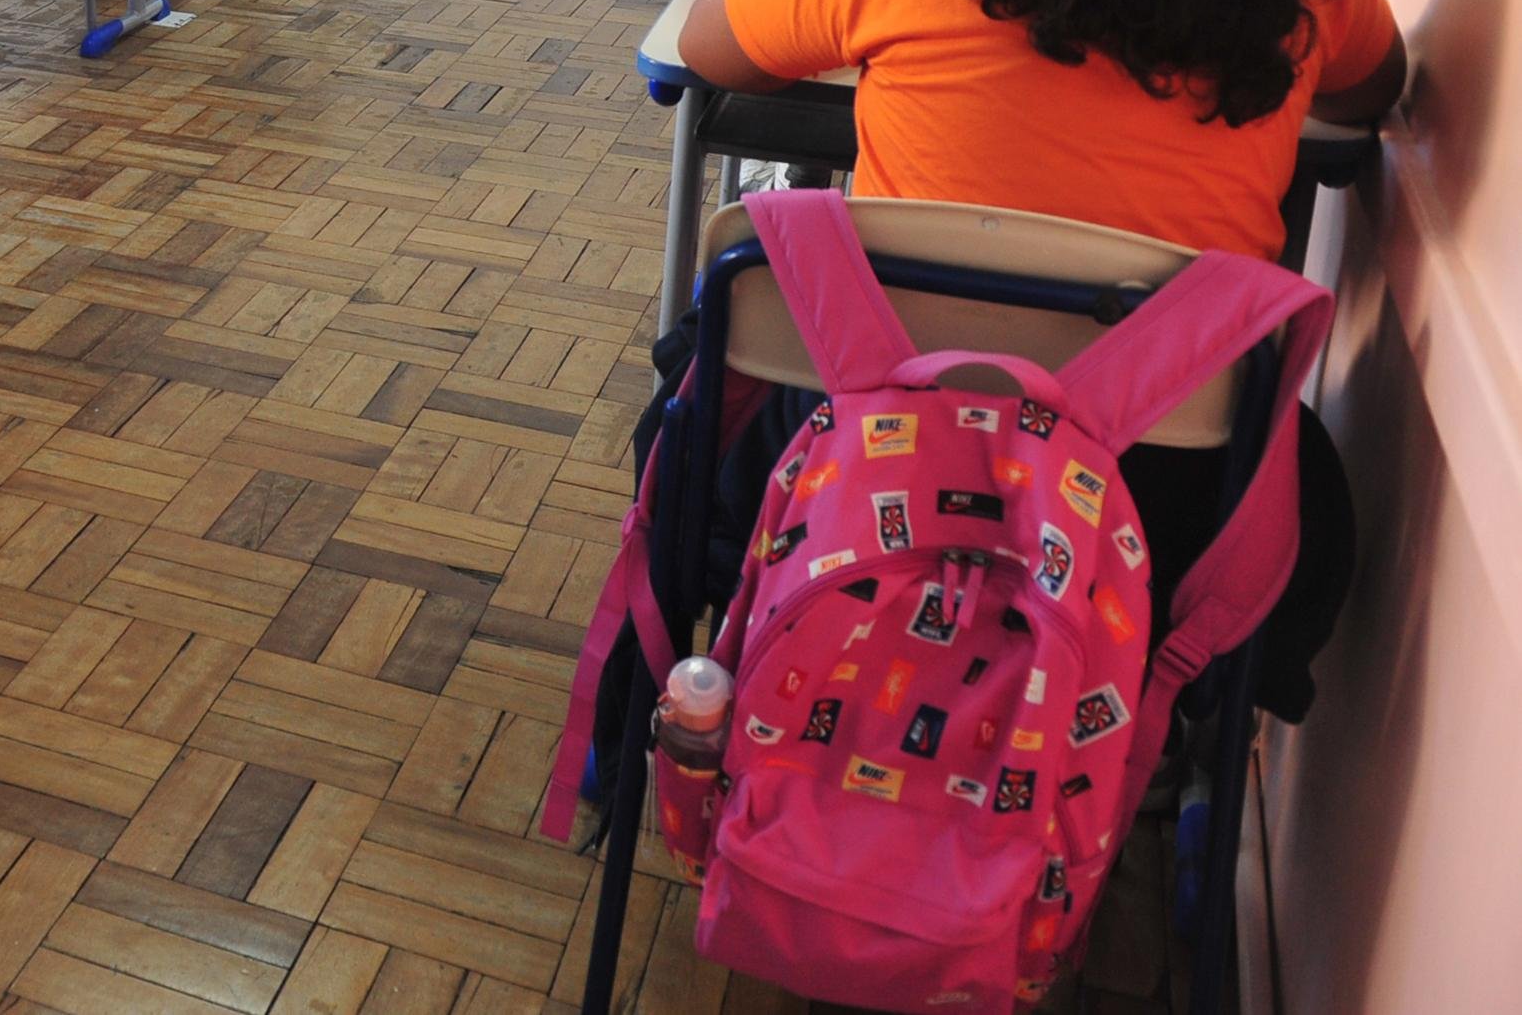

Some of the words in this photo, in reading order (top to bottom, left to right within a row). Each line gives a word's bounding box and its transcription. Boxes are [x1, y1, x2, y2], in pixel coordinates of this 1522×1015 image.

[875, 418, 902, 433] NIKE
[1075, 471, 1103, 493] NIKE
[857, 764, 888, 781] NIKE
